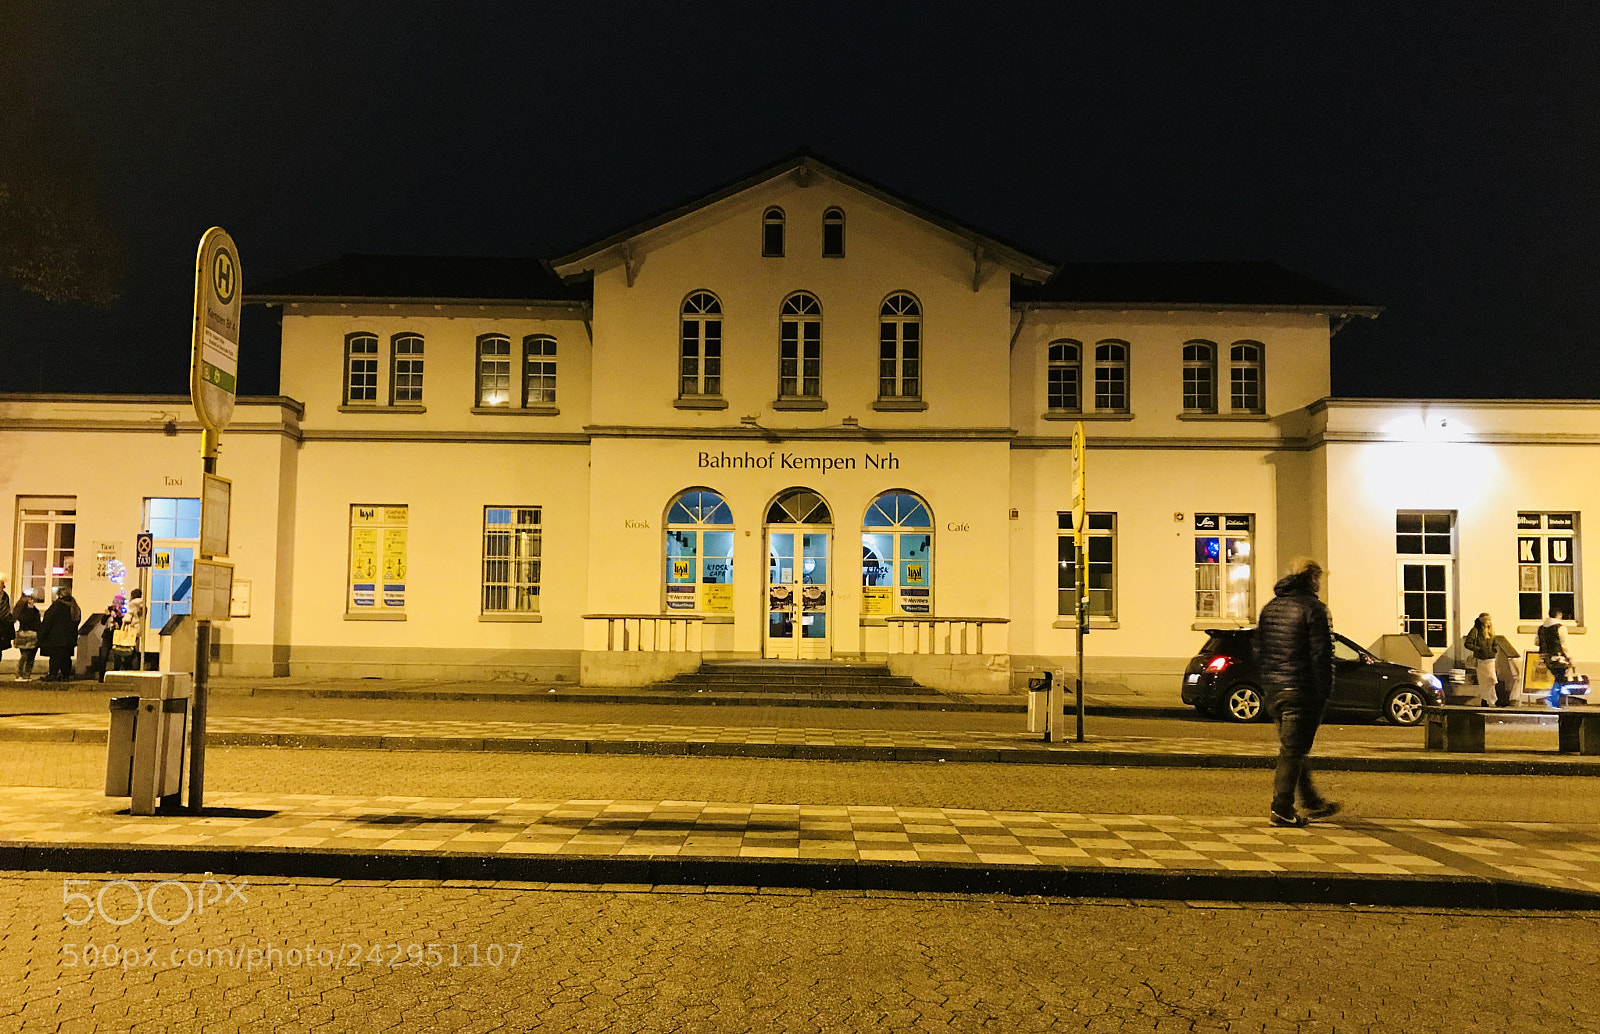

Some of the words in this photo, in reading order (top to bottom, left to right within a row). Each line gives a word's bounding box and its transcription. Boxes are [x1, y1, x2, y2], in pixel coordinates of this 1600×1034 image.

[698, 451, 775, 469] Bahnhof
[781, 453, 856, 475] Kempen
[865, 452, 899, 470] Nrh
[163, 475, 183, 486] Taxi
[625, 519, 650, 529] Kiosk
[947, 521, 970, 532] Café
[138, 556, 151, 566] TAXI
[706, 563, 729, 571] KIOSK
